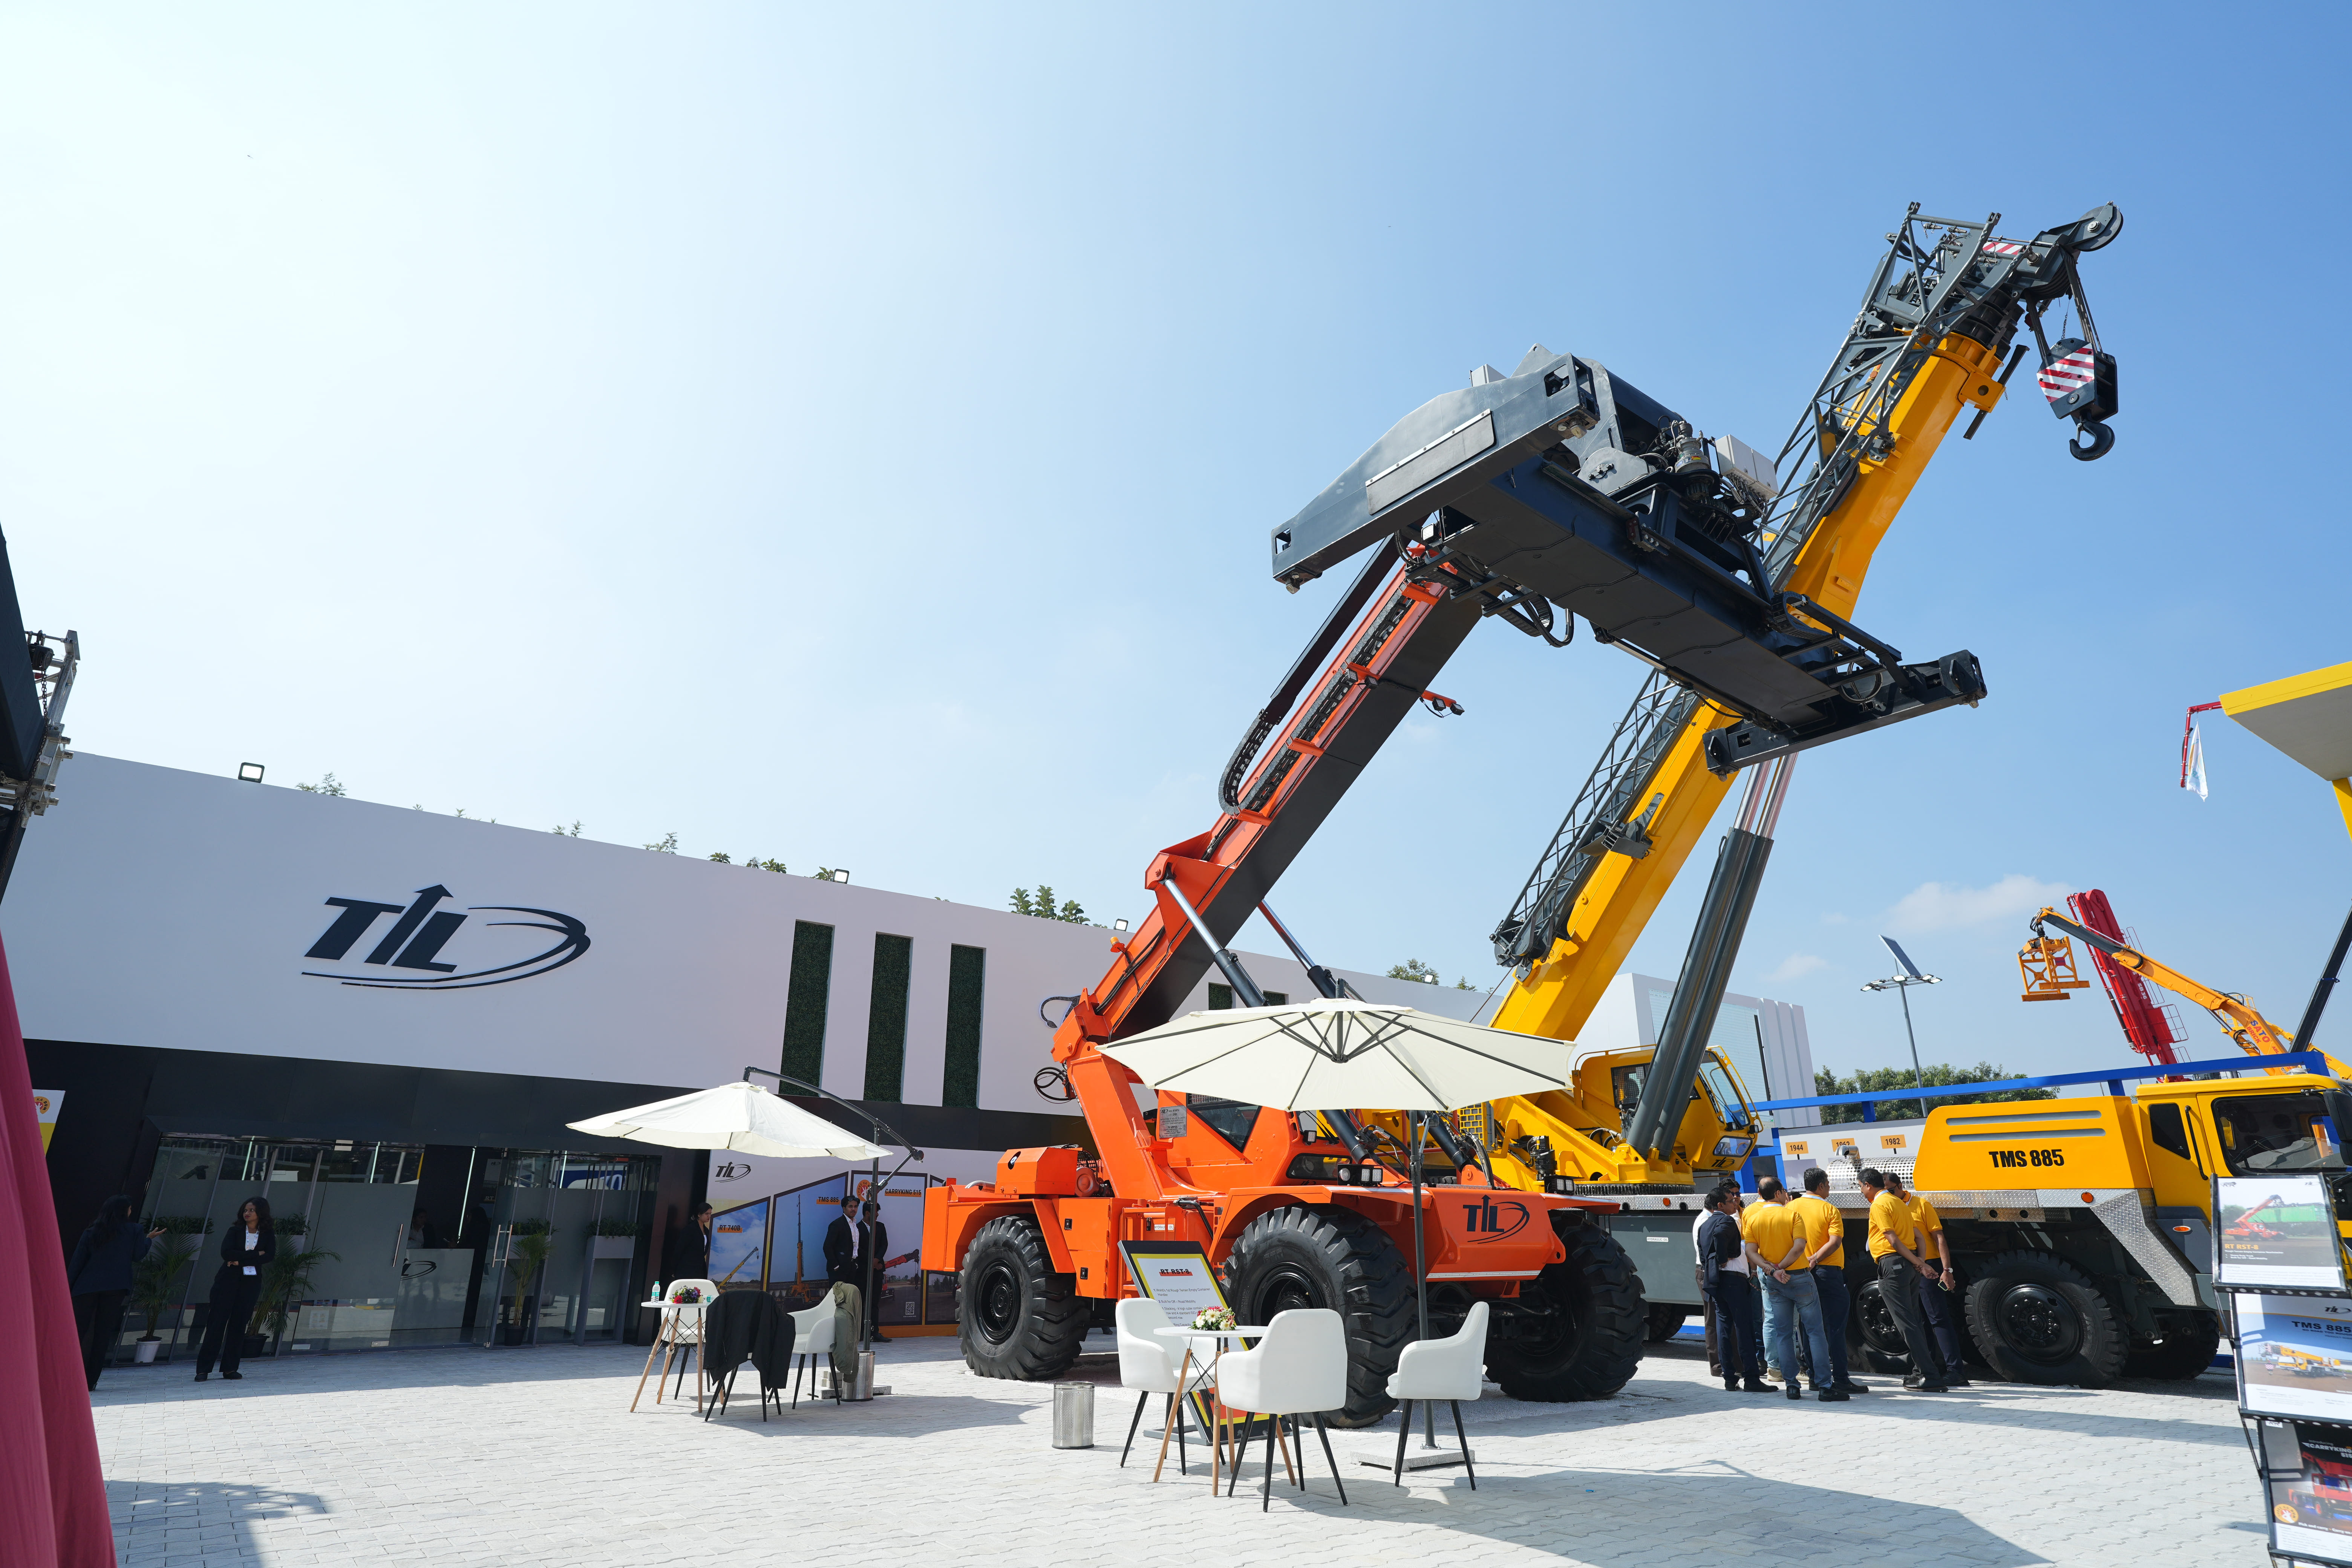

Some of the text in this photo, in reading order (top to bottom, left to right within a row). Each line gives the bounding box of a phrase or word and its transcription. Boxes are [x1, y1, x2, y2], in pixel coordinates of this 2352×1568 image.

[304, 884, 468, 973] TIL
[2138, 983, 2147, 1000] SB36
[2246, 1026, 2261, 1043] BRICK
[2250, 1020, 2270, 1043] SATO
[1988, 1149, 2064, 1168] TMS 885
[715, 1161, 735, 1178] TIL
[1463, 1194, 1504, 1232] TIL
[2291, 1321, 2352, 1333] TMS 885
